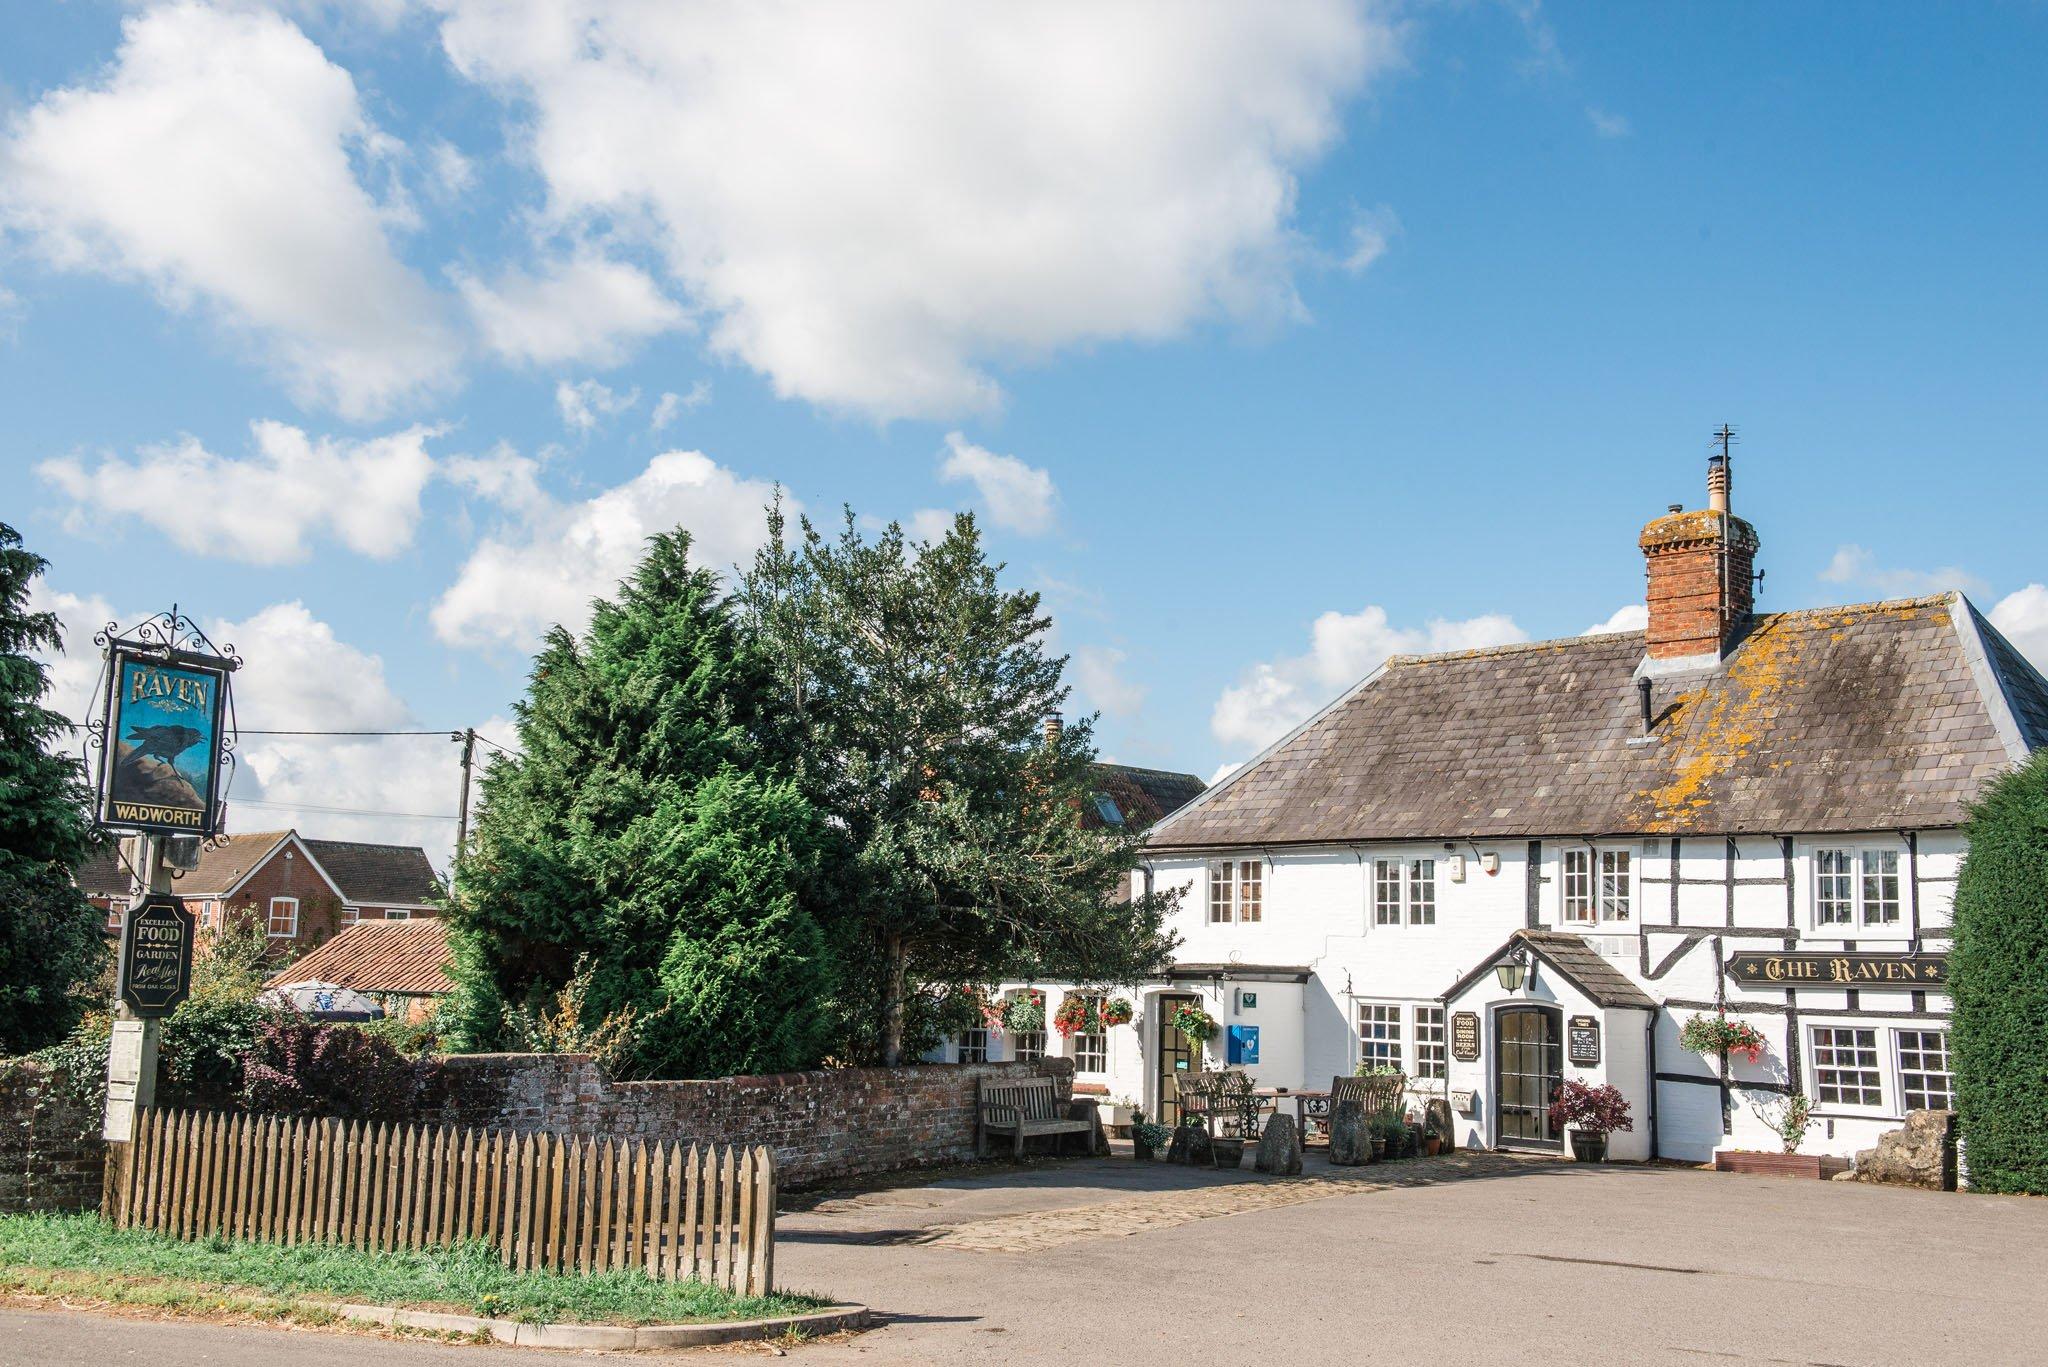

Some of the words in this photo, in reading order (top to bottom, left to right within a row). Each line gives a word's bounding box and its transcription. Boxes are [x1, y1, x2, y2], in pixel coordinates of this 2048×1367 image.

[131, 670, 209, 712] RAVEN
[115, 804, 202, 826] WADWORTH
[140, 918, 179, 927] EXCELLENT
[137, 926, 180, 942] FOOD
[136, 950, 179, 960] GARDEN
[134, 960, 163, 979] Real
[1765, 957, 1819, 981] THE
[1830, 957, 1917, 983] RAVEN
